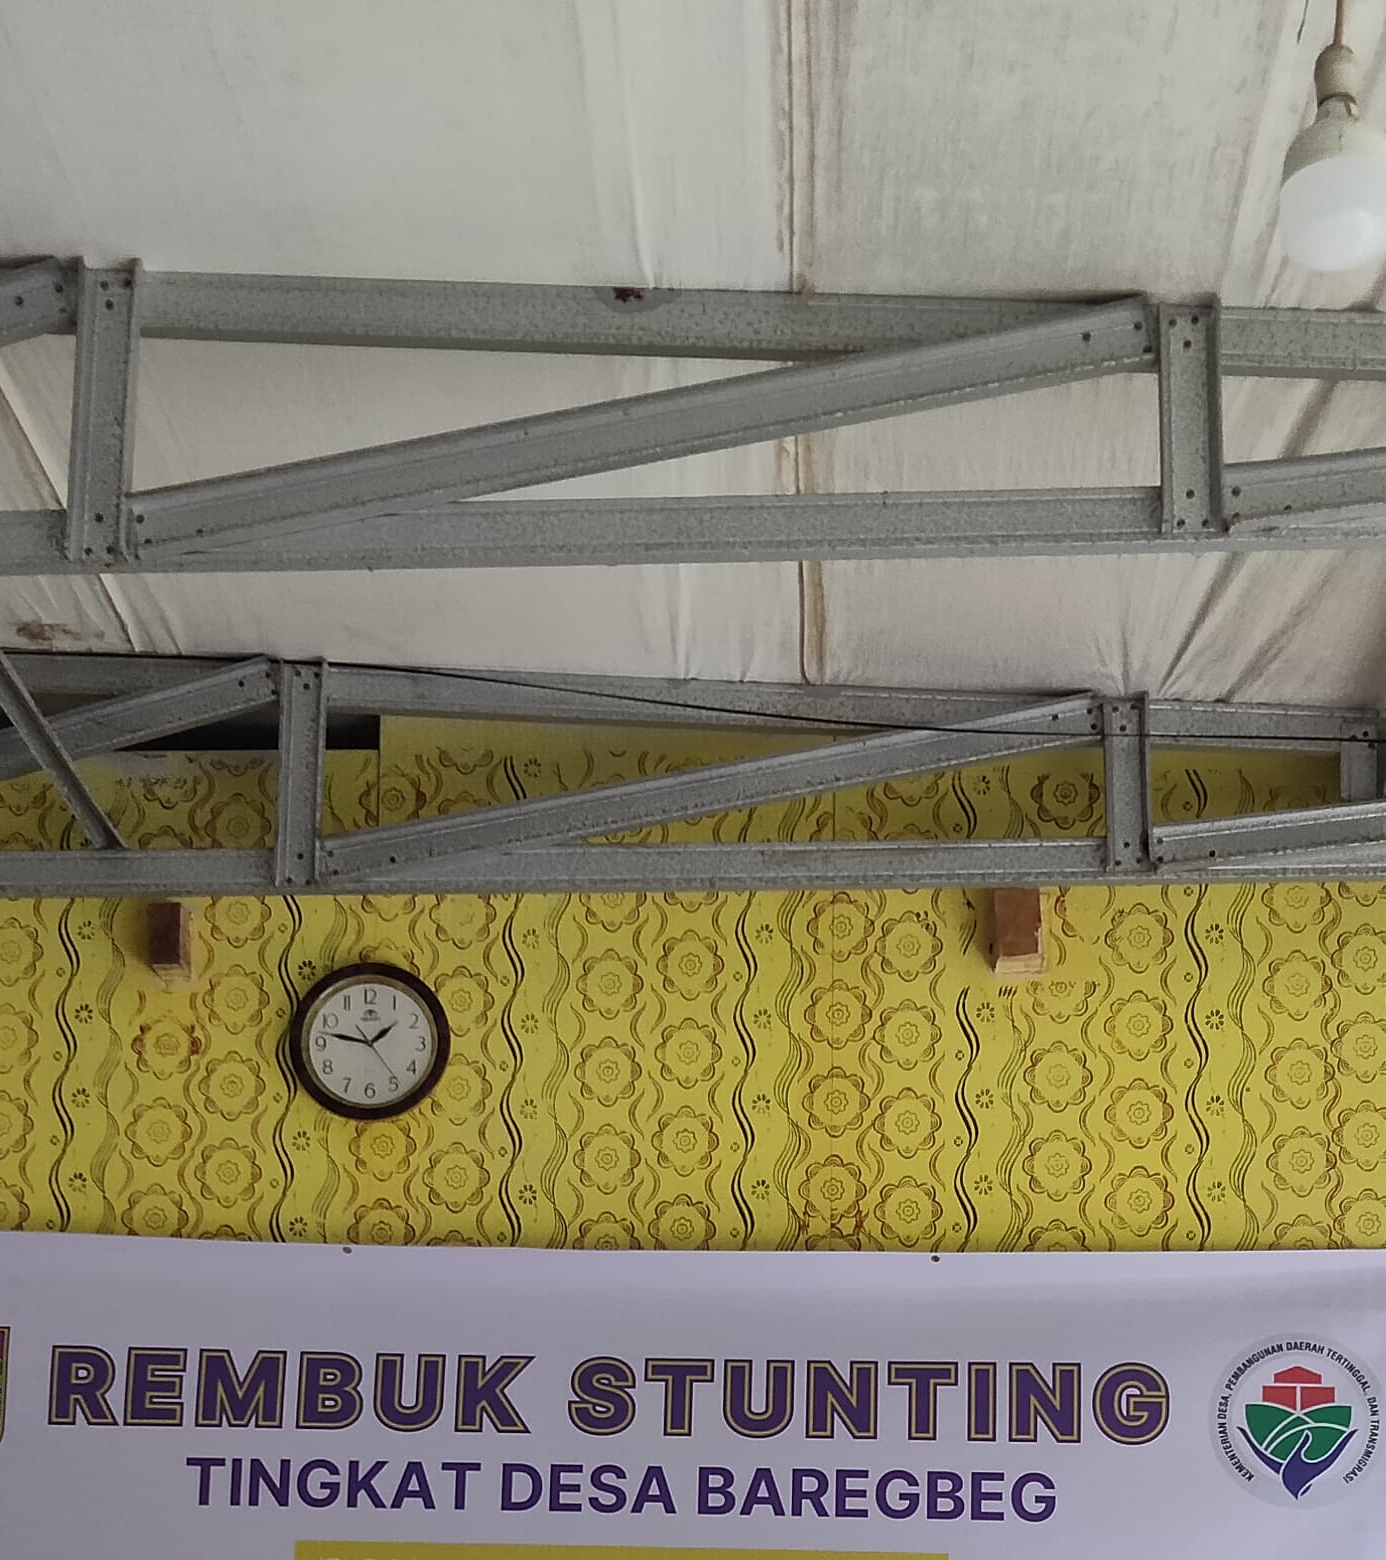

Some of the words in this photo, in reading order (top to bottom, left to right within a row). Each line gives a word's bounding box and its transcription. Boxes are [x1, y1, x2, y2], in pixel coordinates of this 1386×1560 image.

[343, 994, 351, 1011] 11
[364, 988, 377, 1005] 12
[392, 995, 397, 1010] 1
[322, 1013, 339, 1029] 10
[408, 1013, 419, 1029] 2
[315, 1035, 327, 1051] 9
[415, 1036, 427, 1052] 3
[322, 1059, 334, 1075] 8
[406, 1059, 417, 1075] 4
[341, 1077, 353, 1094] 7
[364, 1082, 376, 1099] 6
[388, 1076, 399, 1092] 5
[1286, 1341, 1325, 1355] DAERAH
[1225, 1343, 1284, 1391] PEMBANGUNAN
[48, 1345, 535, 1433] REMBUK
[568, 1357, 1170, 1445] STUNTING
[1366, 1396, 1380, 1417] DAN
[1217, 1421, 1255, 1483] KEMENTERIAN
[1342, 1419, 1381, 1484] TRANSMIGRASI
[186, 1458, 481, 1510] TINGKAT
[500, 1463, 677, 1514] DESA
[697, 1467, 1056, 1522] BAREGBEG
